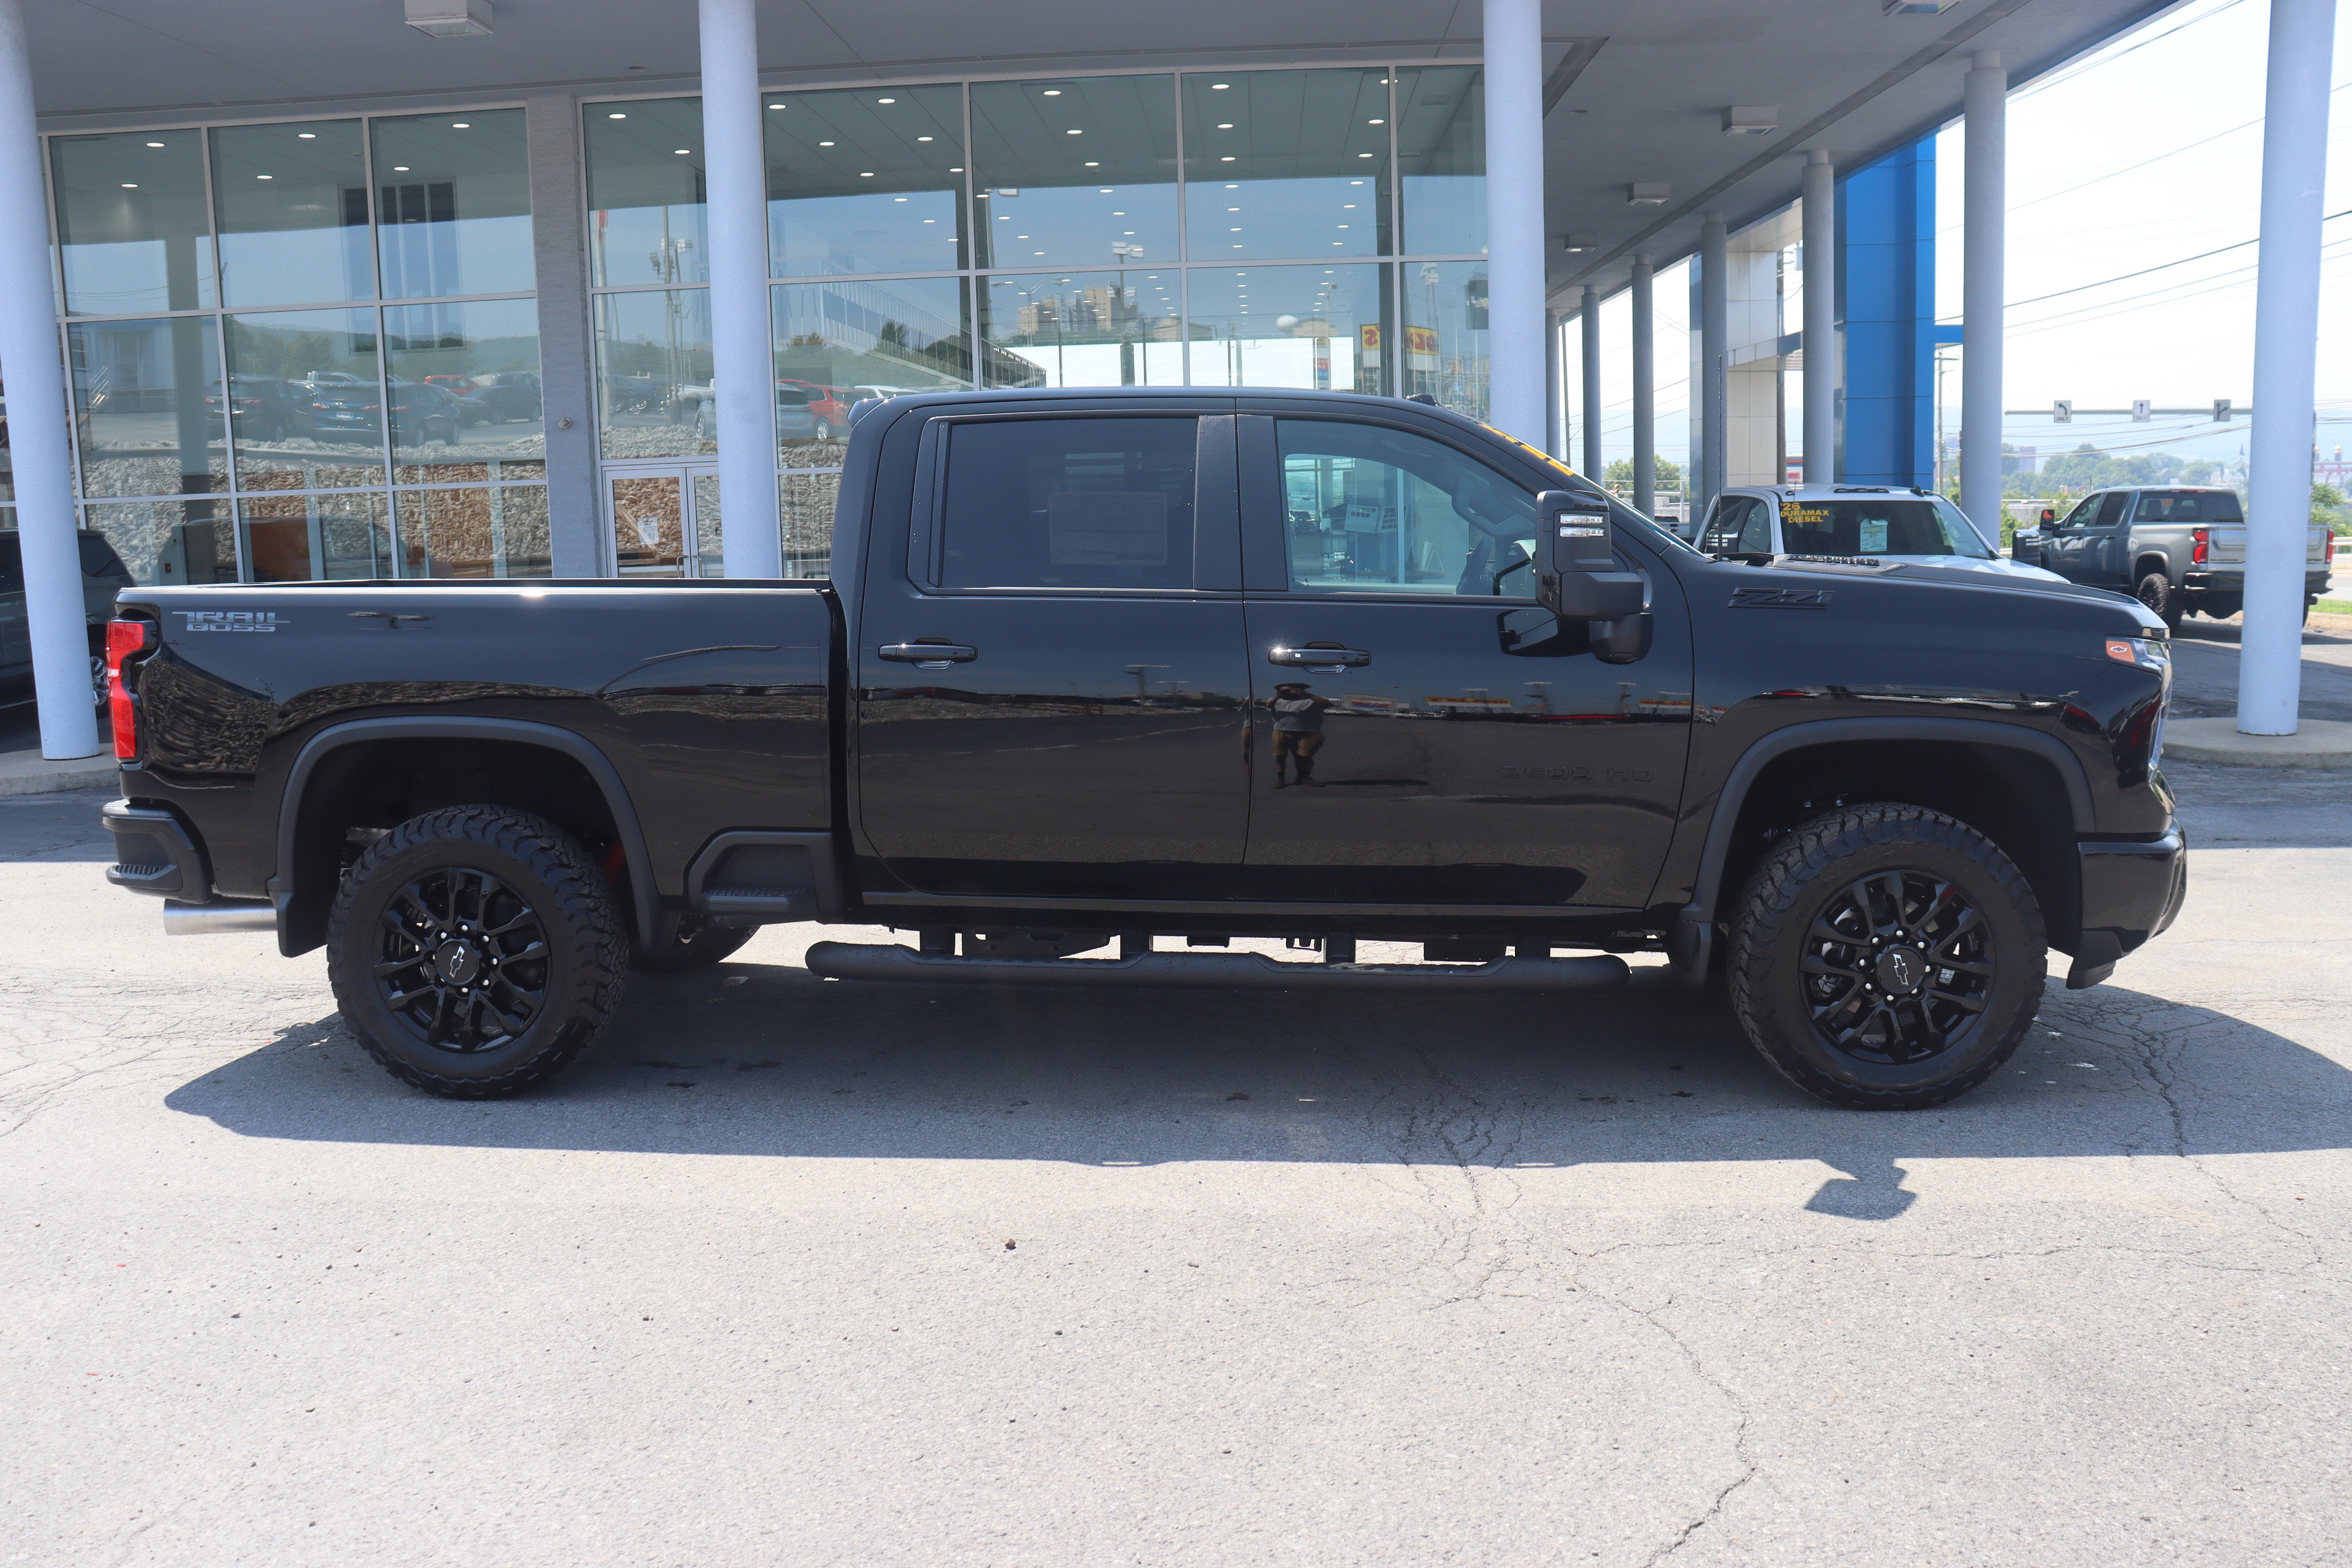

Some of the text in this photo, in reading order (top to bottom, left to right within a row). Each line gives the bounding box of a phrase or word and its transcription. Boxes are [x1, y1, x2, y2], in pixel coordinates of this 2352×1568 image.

[1727, 587, 1835, 610] Z71
[172, 611, 290, 623] TRAIL
[187, 623, 276, 632] BOSS
[1501, 766, 1654, 782] 2500 HD
